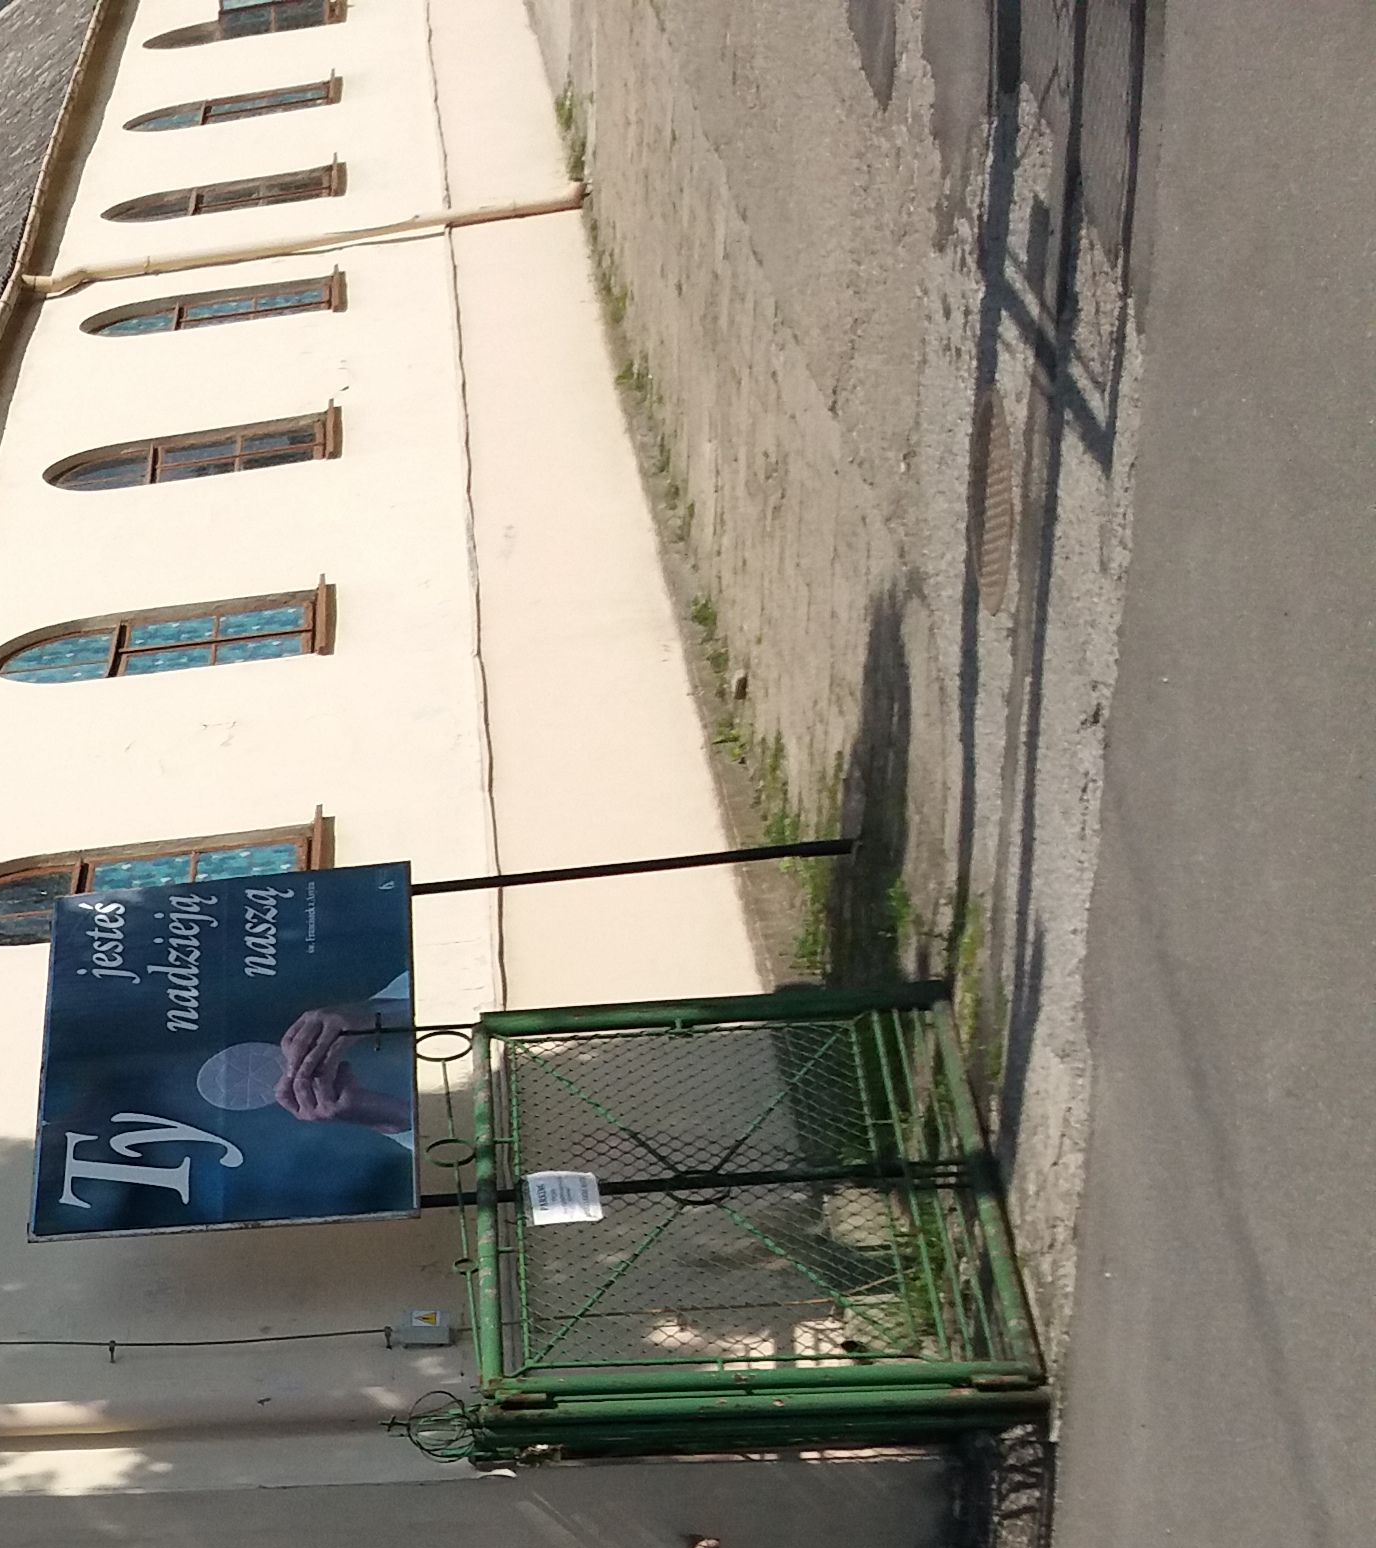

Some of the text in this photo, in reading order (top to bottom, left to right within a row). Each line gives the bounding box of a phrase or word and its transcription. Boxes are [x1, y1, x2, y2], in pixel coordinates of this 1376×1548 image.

[77, 902, 141, 984] jesteś
[147, 894, 218, 1032] nadzieją
[243, 887, 294, 977] naszą
[59, 1112, 244, 1208] Ty
